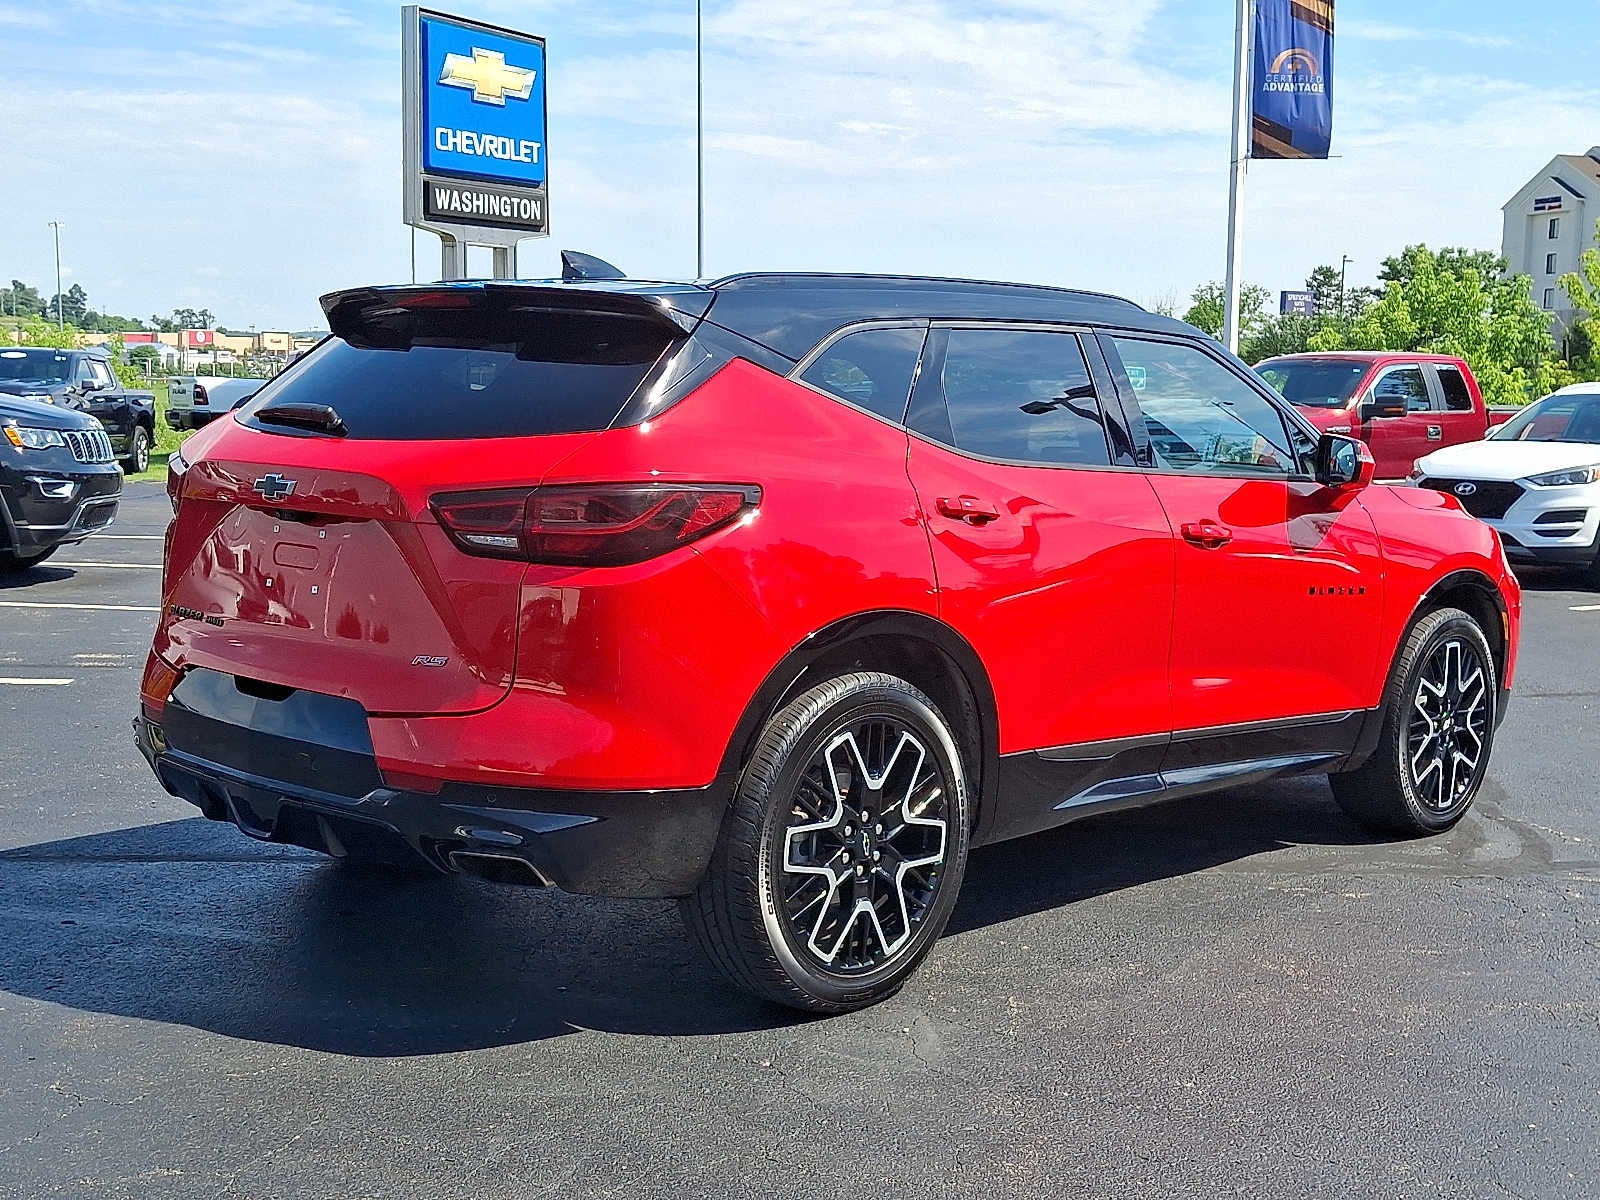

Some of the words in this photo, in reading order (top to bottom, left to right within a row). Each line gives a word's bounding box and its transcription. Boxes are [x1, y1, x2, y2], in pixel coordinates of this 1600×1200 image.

[1265, 74, 1322, 83] CERTIFIED
[1262, 82, 1325, 93] ADVANTAGE
[434, 127, 541, 164] CHEVROLET
[434, 187, 541, 221] WASHINGTON
[411, 655, 449, 667] RS
